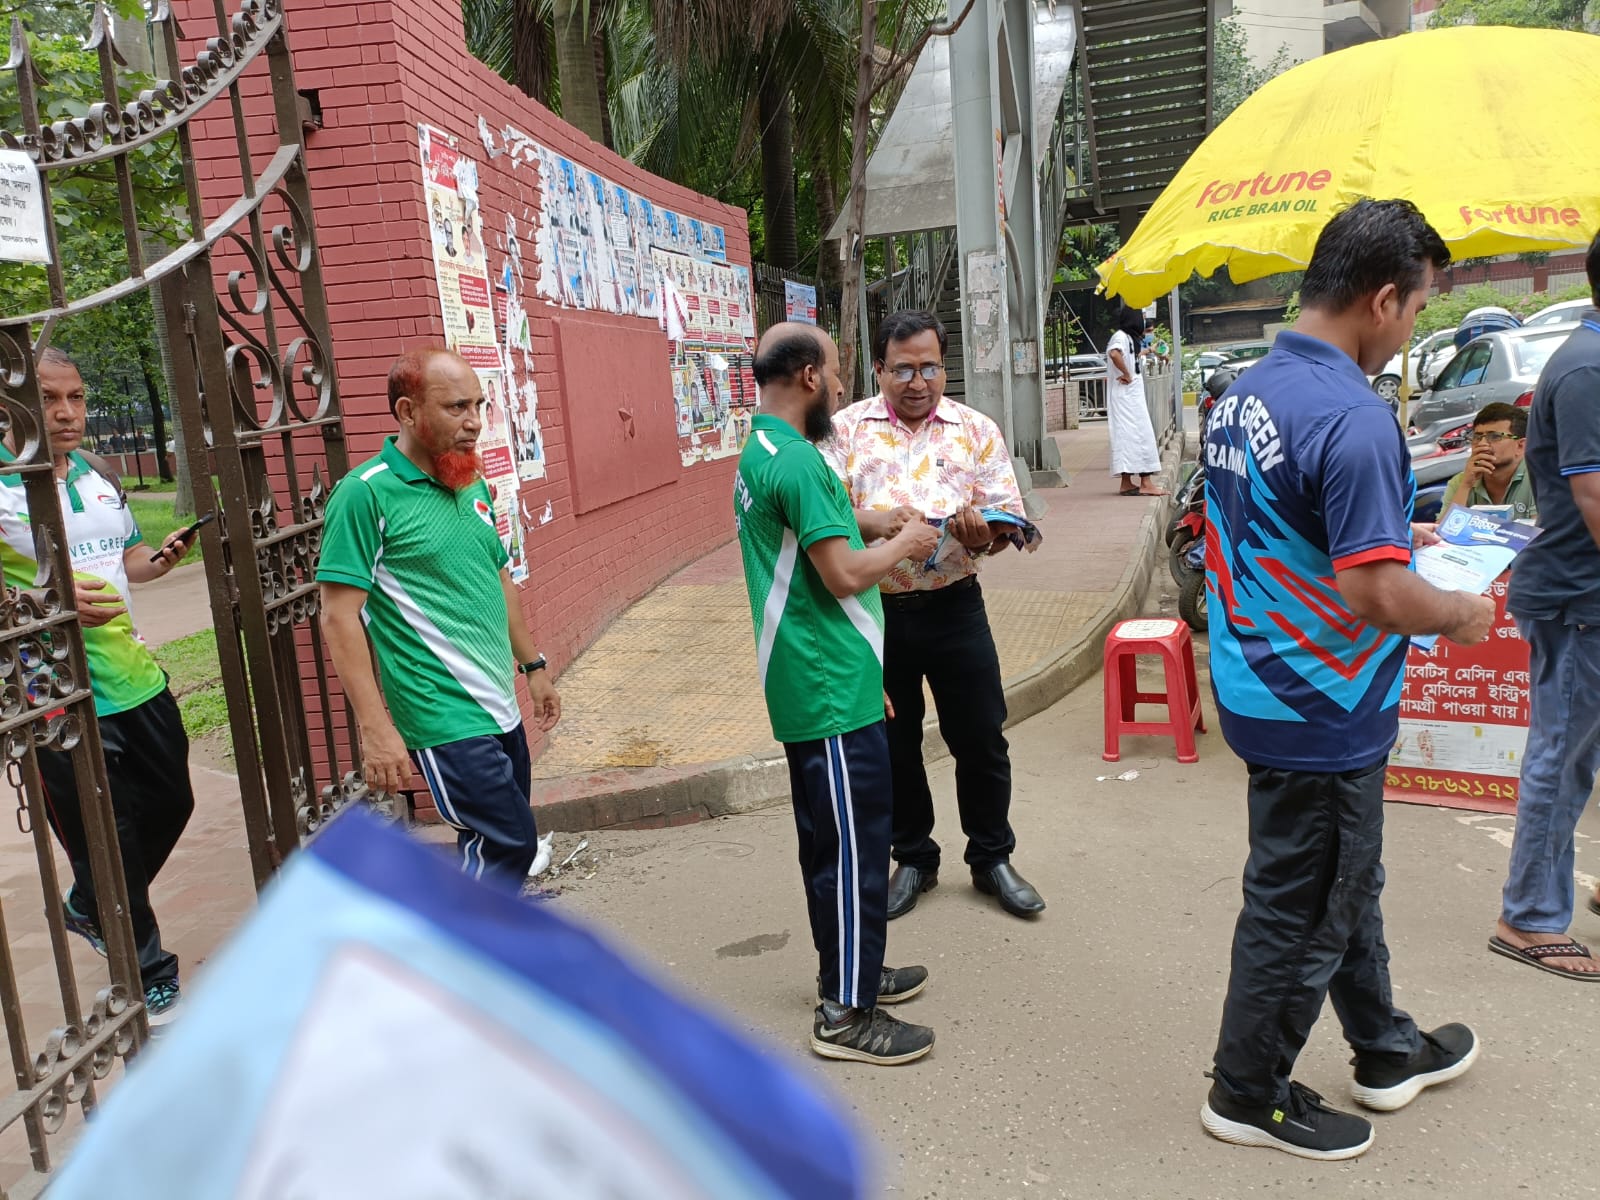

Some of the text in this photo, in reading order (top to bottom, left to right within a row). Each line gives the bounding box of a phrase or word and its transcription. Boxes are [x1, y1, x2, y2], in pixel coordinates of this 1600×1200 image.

[1196, 169, 1332, 208] fortune
[1207, 199, 1317, 223] RICE BRAN OIL
[1460, 204, 1581, 227] fortune
[1206, 395, 1285, 472] VER GREEN
[70, 536, 125, 558] VER GREE
[1405, 662, 1449, 680] াবেটিস
[1455, 664, 1498, 683] মেসিন
[1422, 680, 1478, 699] মেসিনের
[1442, 701, 1487, 718] পাওয়া
[1490, 704, 1520, 720] যায়
[1384, 771, 1516, 801] ৯১৭৮৬২১৭২
